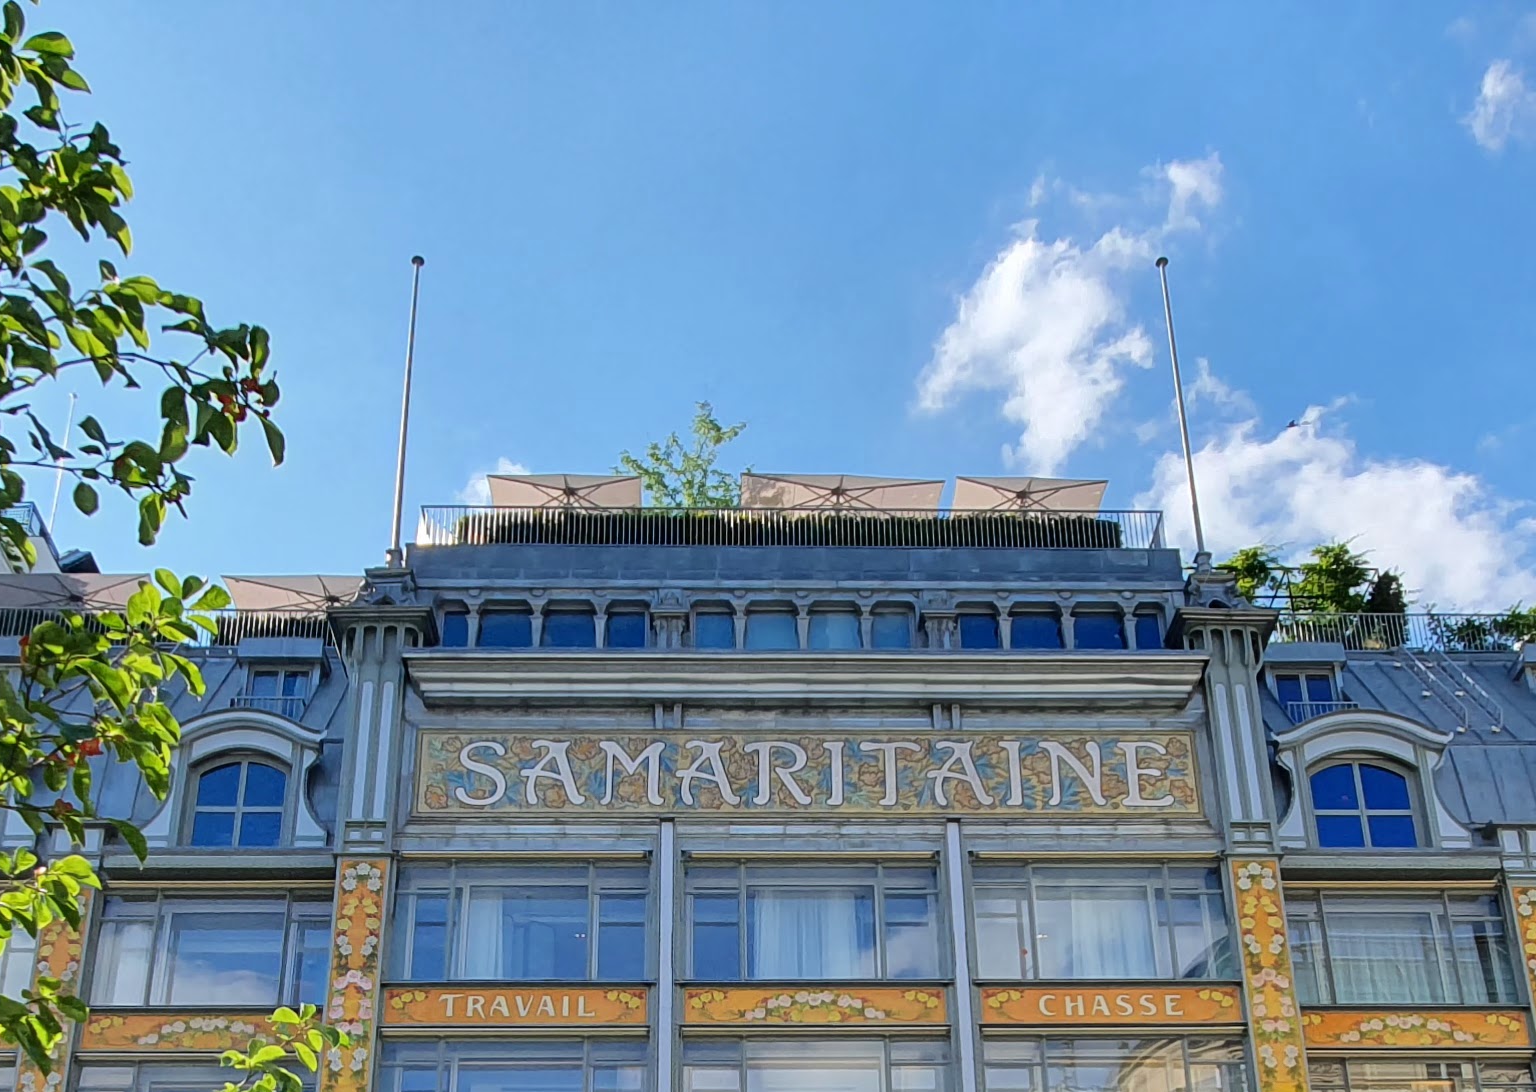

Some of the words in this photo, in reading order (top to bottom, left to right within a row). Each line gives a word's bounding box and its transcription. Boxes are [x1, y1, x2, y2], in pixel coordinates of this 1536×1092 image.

[453, 738, 1177, 808] SAMARITAINE
[438, 994, 596, 1019] TRAVAIL
[1038, 993, 1185, 1017] CHASSE
